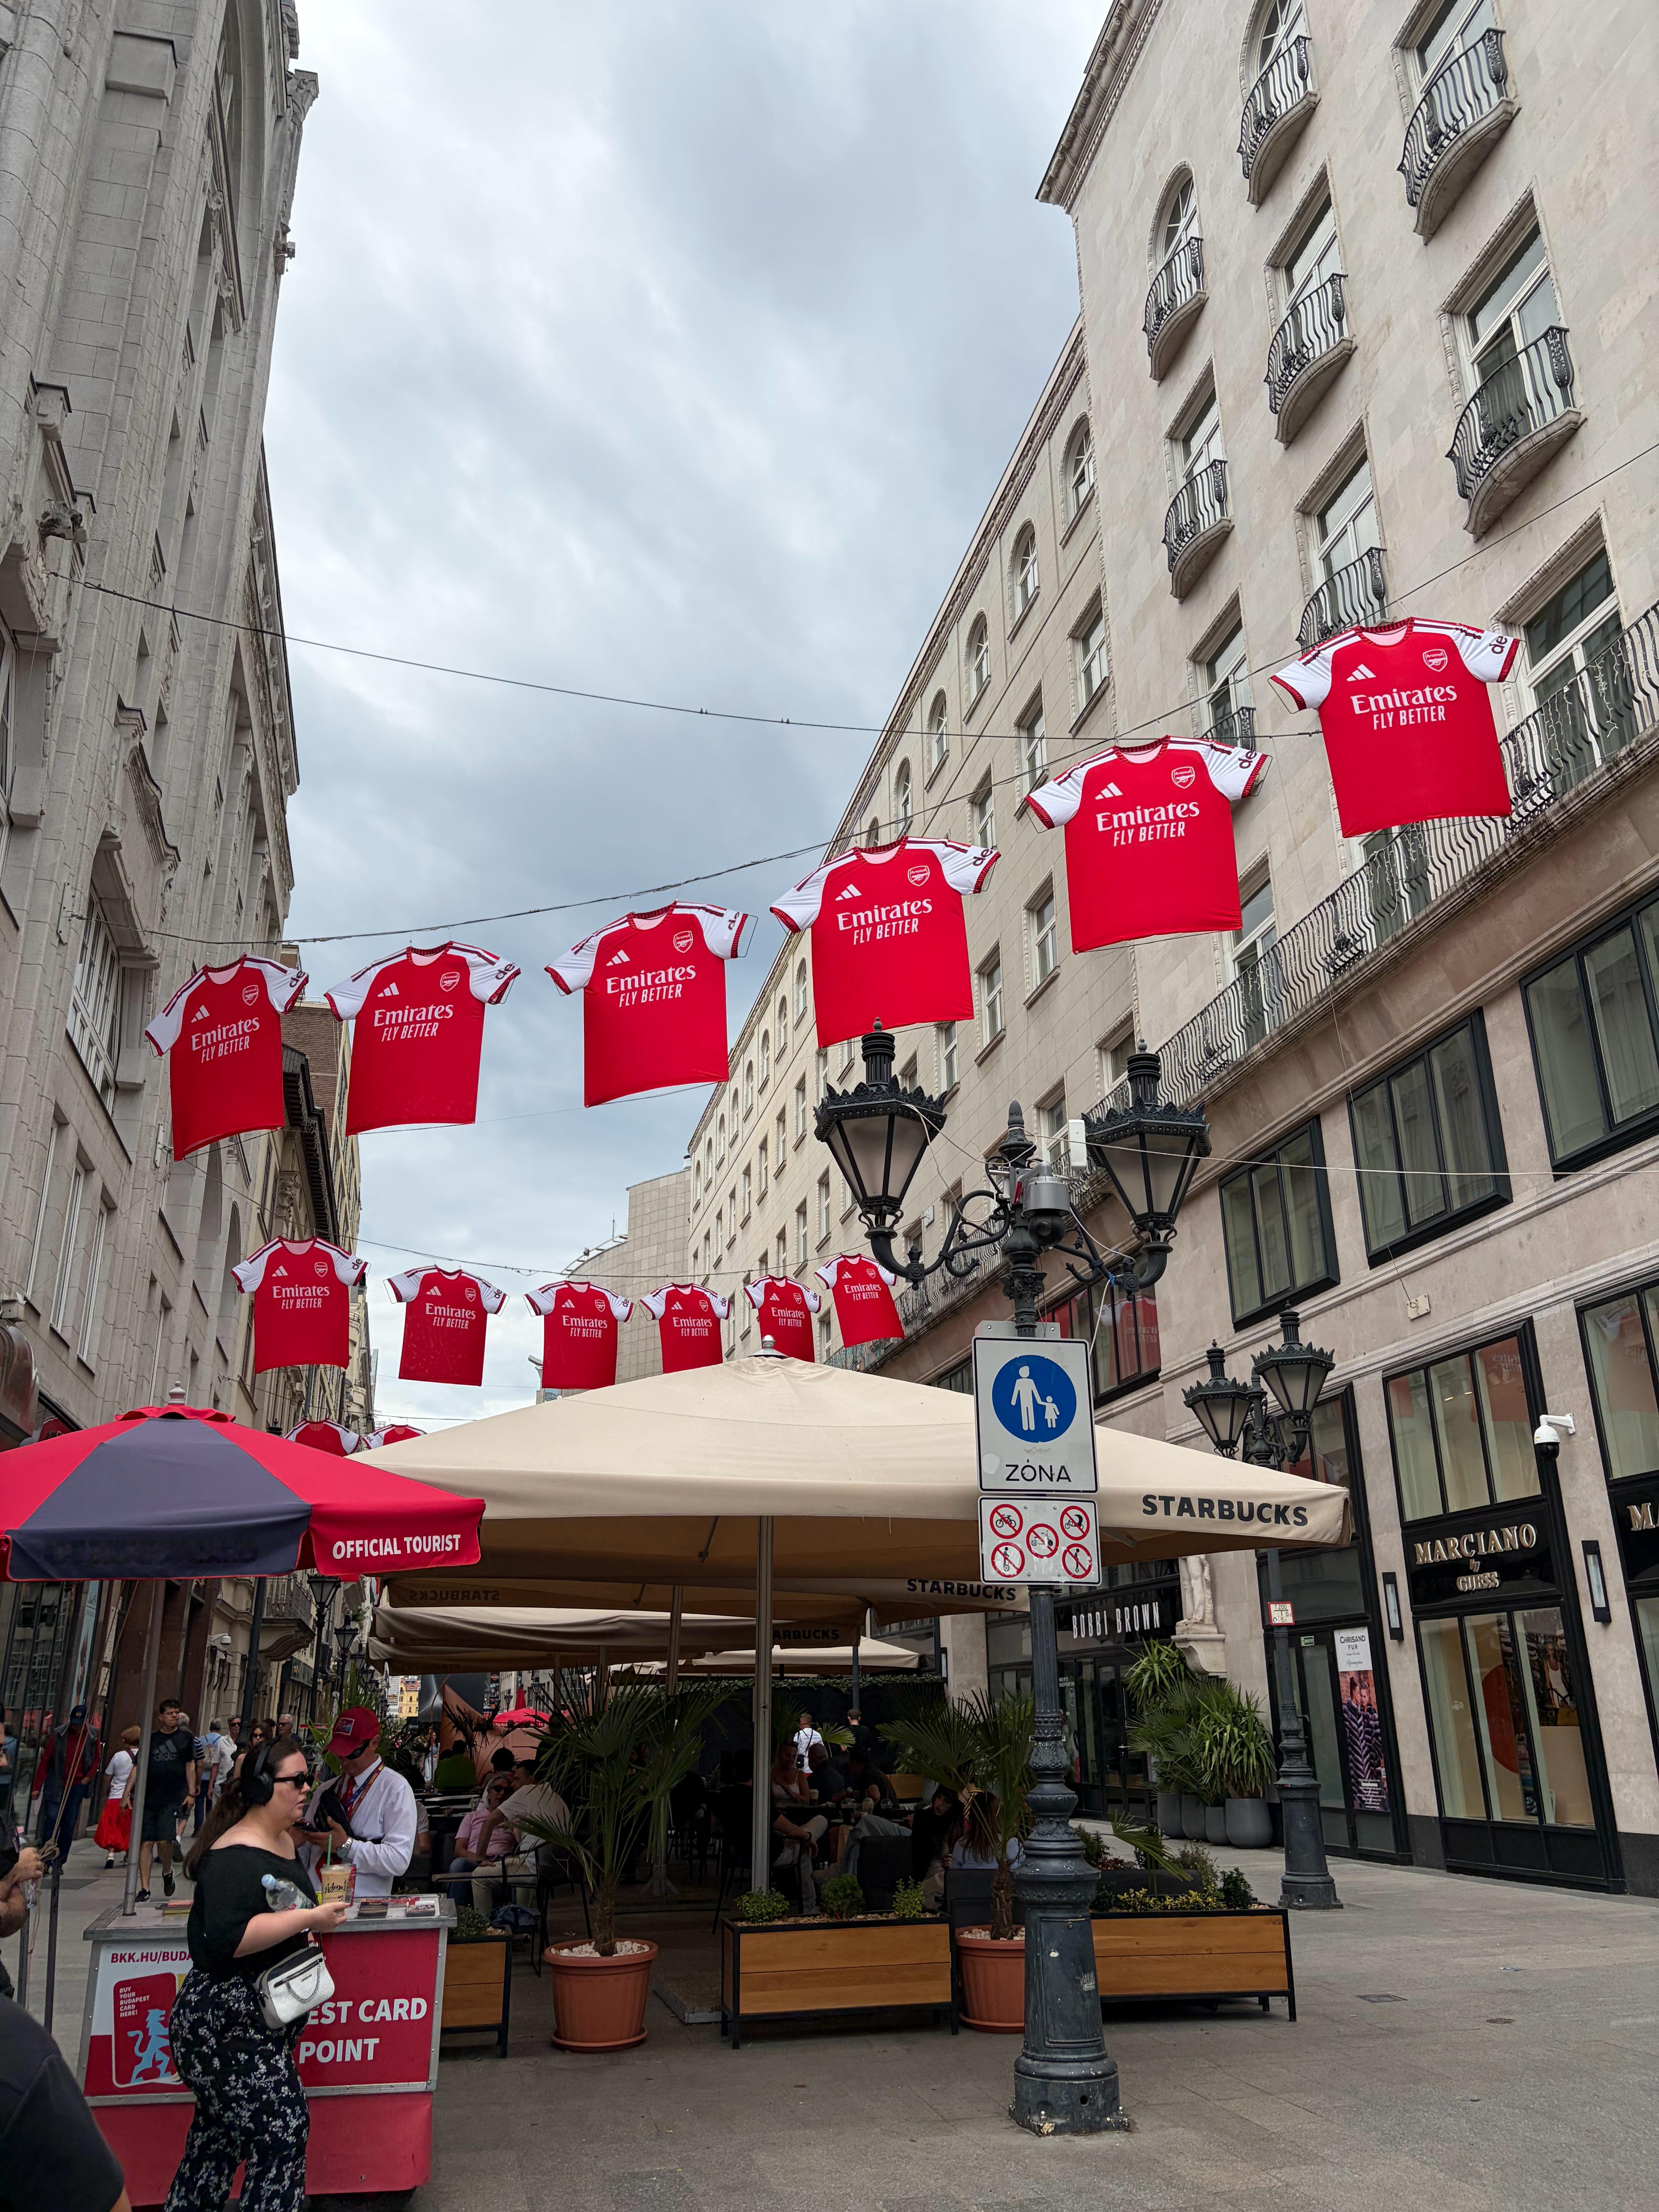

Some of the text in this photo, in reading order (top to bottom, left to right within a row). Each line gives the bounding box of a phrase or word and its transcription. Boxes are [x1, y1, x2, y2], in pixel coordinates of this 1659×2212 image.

[1350, 685, 1457, 714] Emirates
[1373, 705, 1446, 730] FLY BETTER
[1096, 802, 1200, 831] Emirates
[1113, 821, 1185, 847] FLY BETTER
[836, 899, 932, 931] Emirates
[854, 918, 919, 945] FLY BETTER
[606, 965, 696, 994] Emirates
[619, 984, 682, 1007] FLY BETTER
[374, 1004, 453, 1027] Emirates
[191, 1017, 260, 1051] Emirates
[381, 1022, 439, 1042] FLY BETTER
[201, 1036, 249, 1063] FLY BETTER
[272, 1285, 330, 1298] Emirates
[844, 1283, 881, 1293] Emirates
[853, 1291, 879, 1301] FLY BETTER
[282, 1298, 322, 1309] FLY BETTER
[426, 1303, 476, 1320] Emirates
[771, 1307, 805, 1319] Emirates
[433, 1316, 469, 1329] FLY BETTER
[562, 1315, 608, 1329] Emirates
[570, 1328, 602, 1338] FLY BETTER
[673, 1317, 712, 1327] Emirates
[681, 1328, 708, 1336] FLY BETTER
[787, 1318, 802, 1327] BETTER
[1005, 1459, 1072, 1482] ZÓNA
[1142, 1495, 1309, 1527] STARBUCKS
[1627, 1503, 1659, 1531] M
[332, 1534, 461, 1559] OFFICIAL TOURIST
[1414, 1523, 1537, 1565] MARCIANO
[907, 1579, 1016, 1601] STARBUCKS
[1456, 1571, 1500, 1591] GUESS
[1072, 1602, 1160, 1638] BOBBI BROWN
[772, 1629, 839, 1640] ARBUCKS
[1340, 1635, 1365, 1644] CHRISAND
[119, 1995, 150, 2005] BUDAPEST
[358, 1997, 428, 2022] CARD
[299, 2037, 380, 2064] POINT
